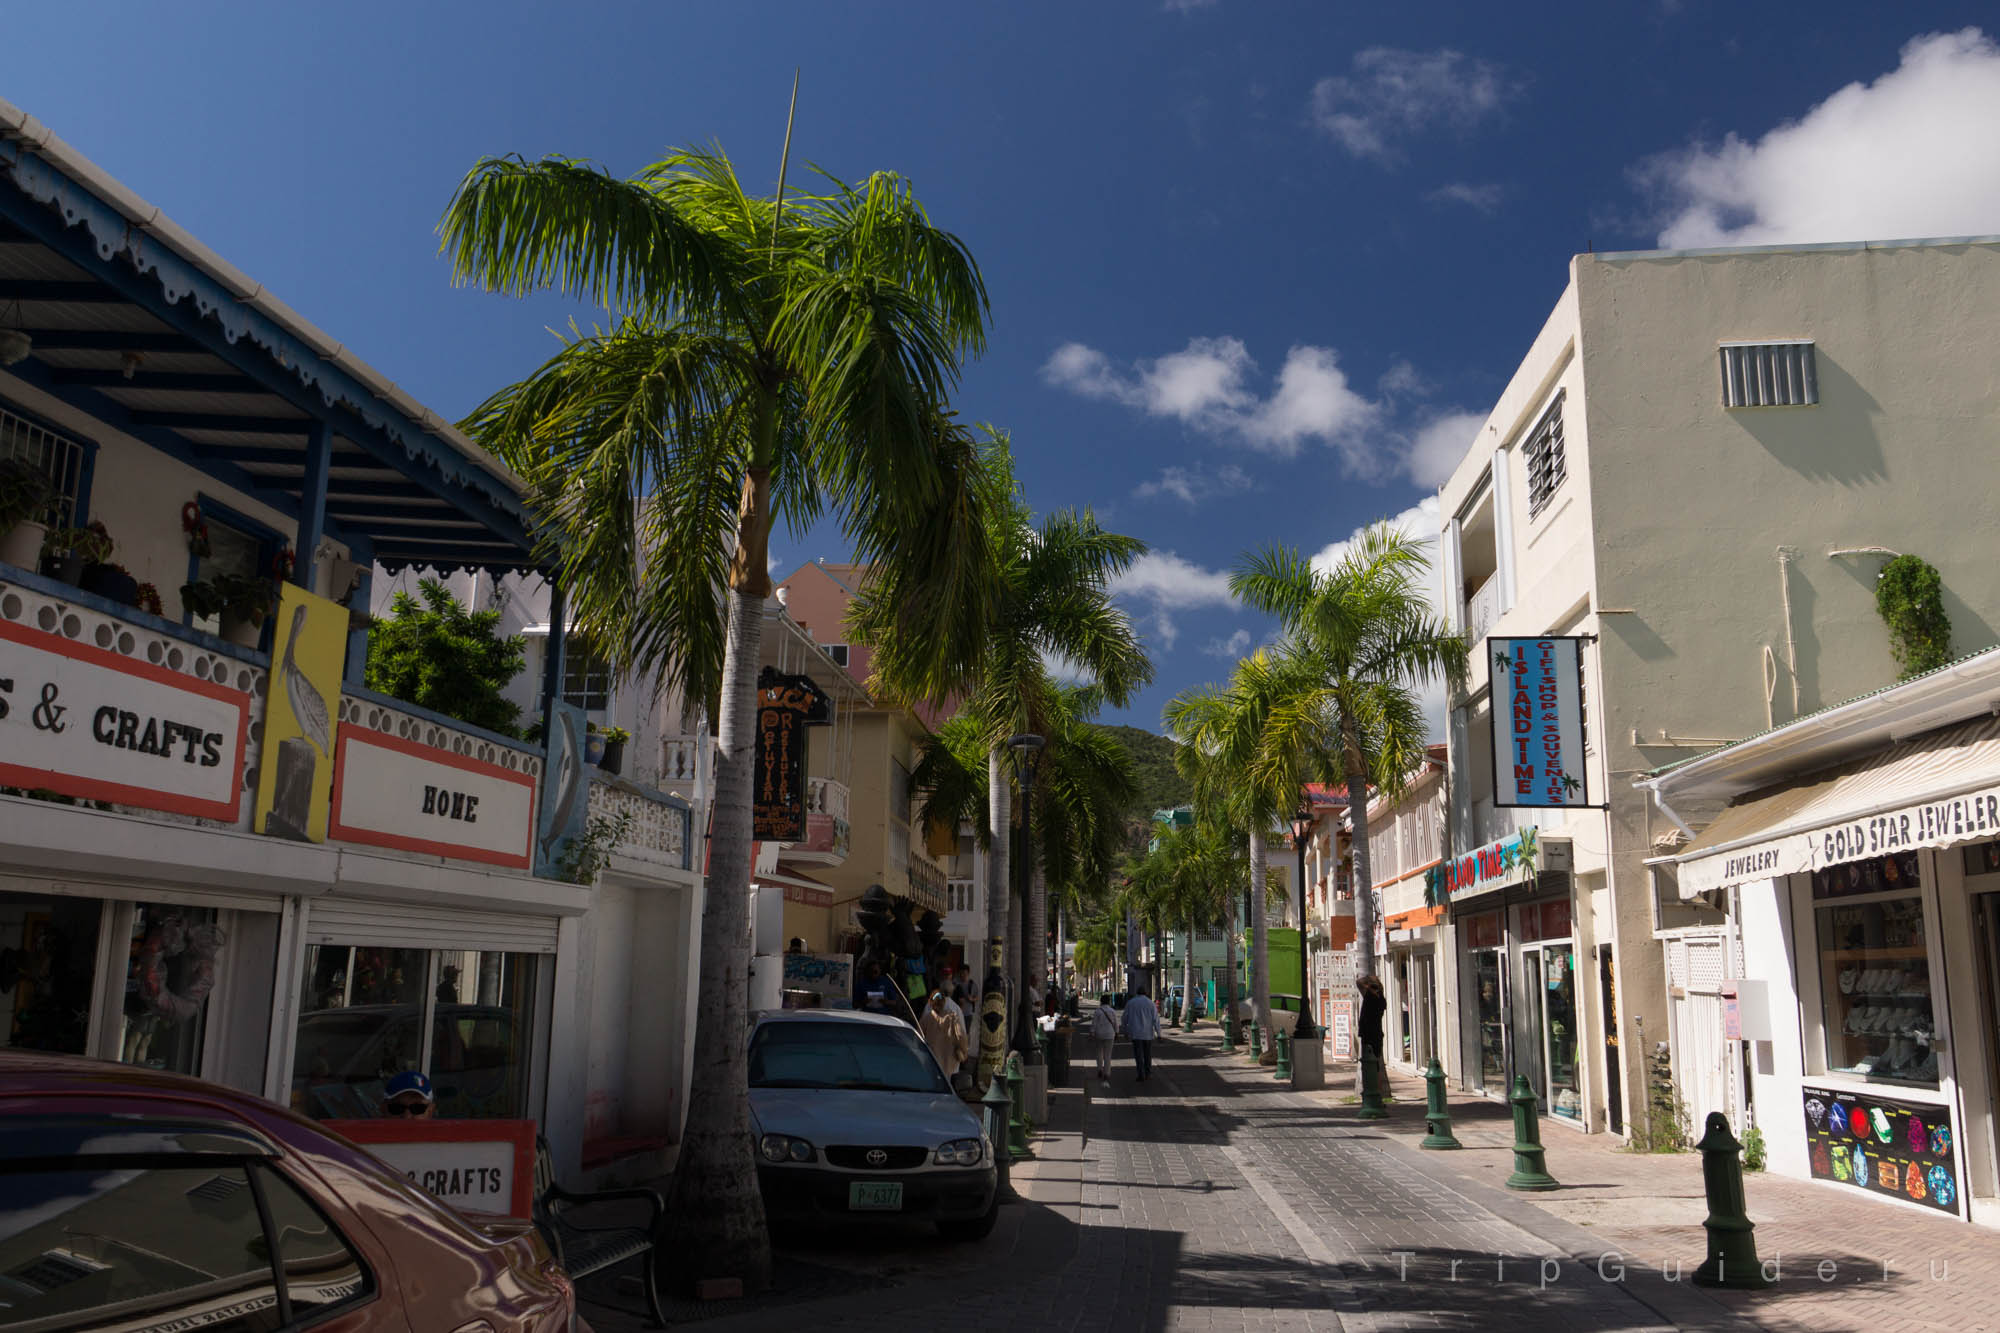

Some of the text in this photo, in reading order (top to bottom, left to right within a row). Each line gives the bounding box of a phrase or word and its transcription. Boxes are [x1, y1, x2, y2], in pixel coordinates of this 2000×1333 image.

[32, 682, 67, 733] &
[93, 705, 223, 767] CRAFTS
[1513, 646, 1534, 794] ISLAND TIME
[1541, 712, 1558, 721] &
[1542, 725, 1562, 804] SOUVENIRS
[422, 785, 479, 823] HOME
[1824, 795, 2000, 863] GOLD STAR JEWELER
[1444, 843, 1504, 894] ISLAND TIME
[1725, 849, 1780, 879] JEWELERY
[423, 1168, 501, 1195] CRAFTS
